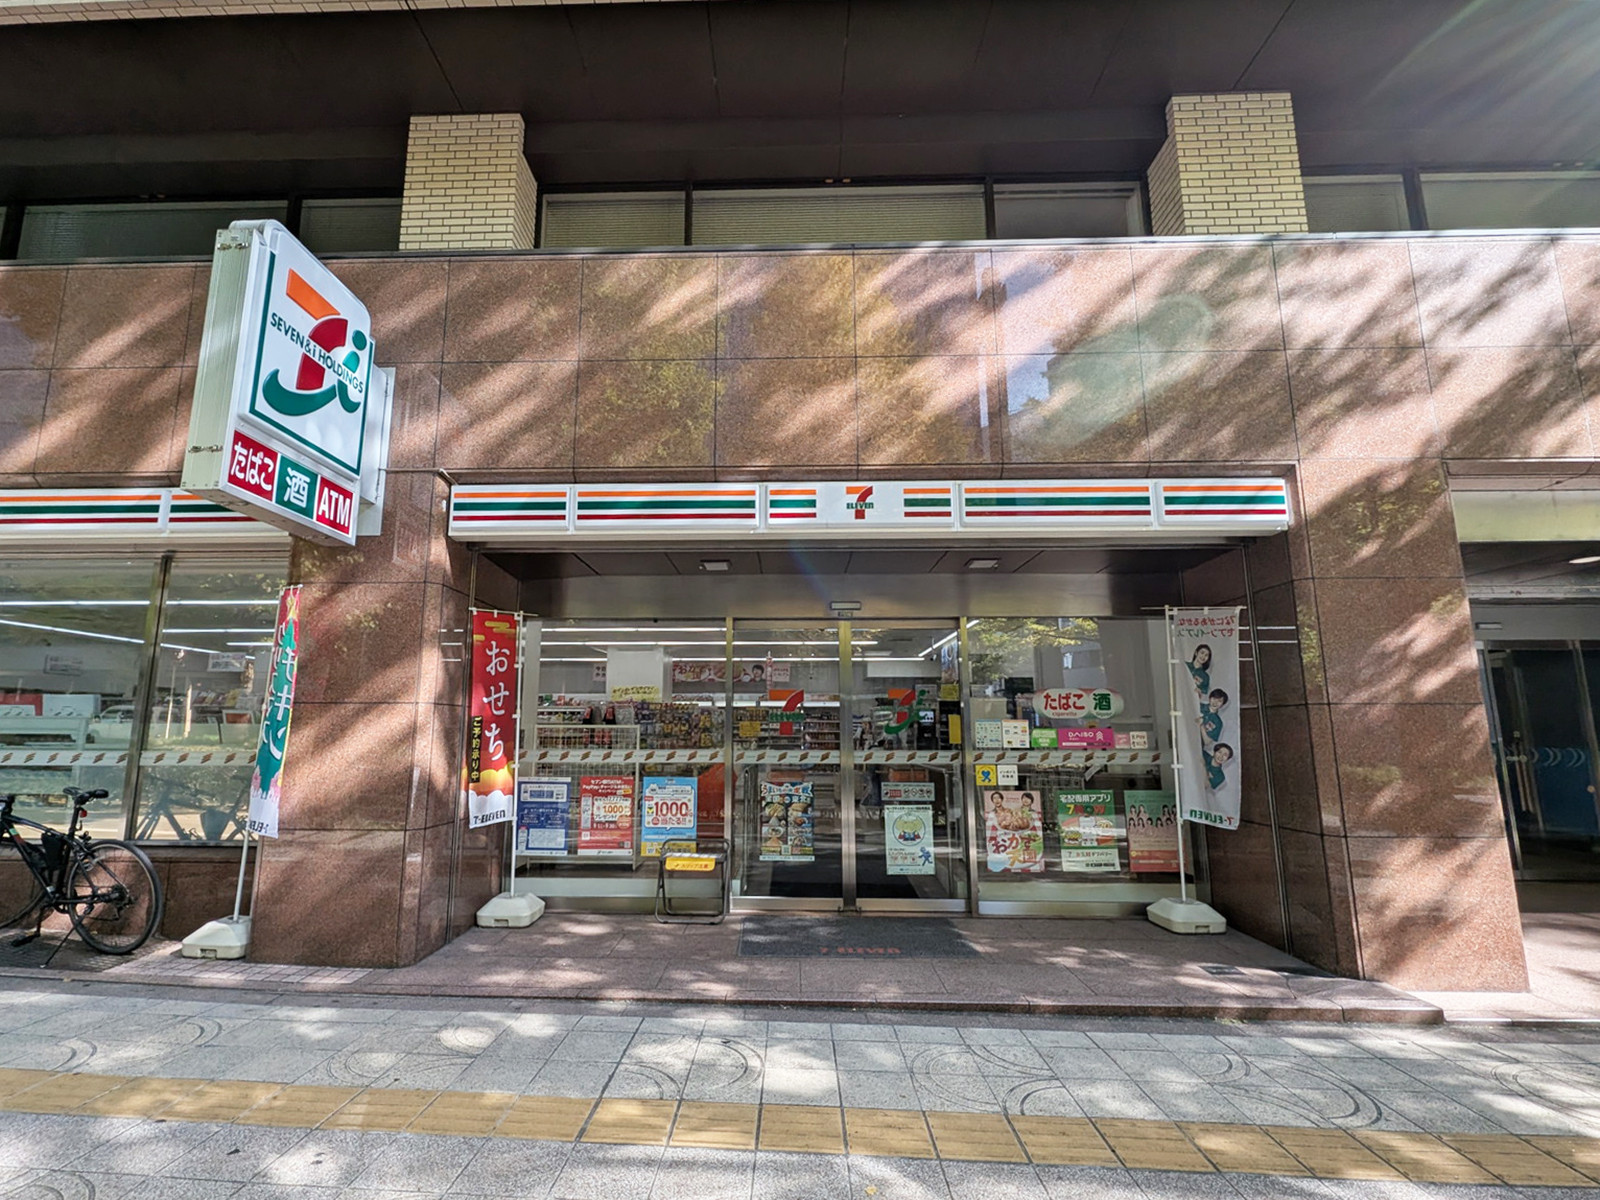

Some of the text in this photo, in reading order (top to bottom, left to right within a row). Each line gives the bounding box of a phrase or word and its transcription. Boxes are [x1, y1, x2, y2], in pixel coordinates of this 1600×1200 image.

[318, 352, 364, 394] HOLDINGS
[230, 441, 352, 528] たばこ 酒 ATM
[483, 641, 510, 761] おせち
[1043, 693, 1111, 711] たばこ 酒
[471, 716, 482, 781] ご予約承り中
